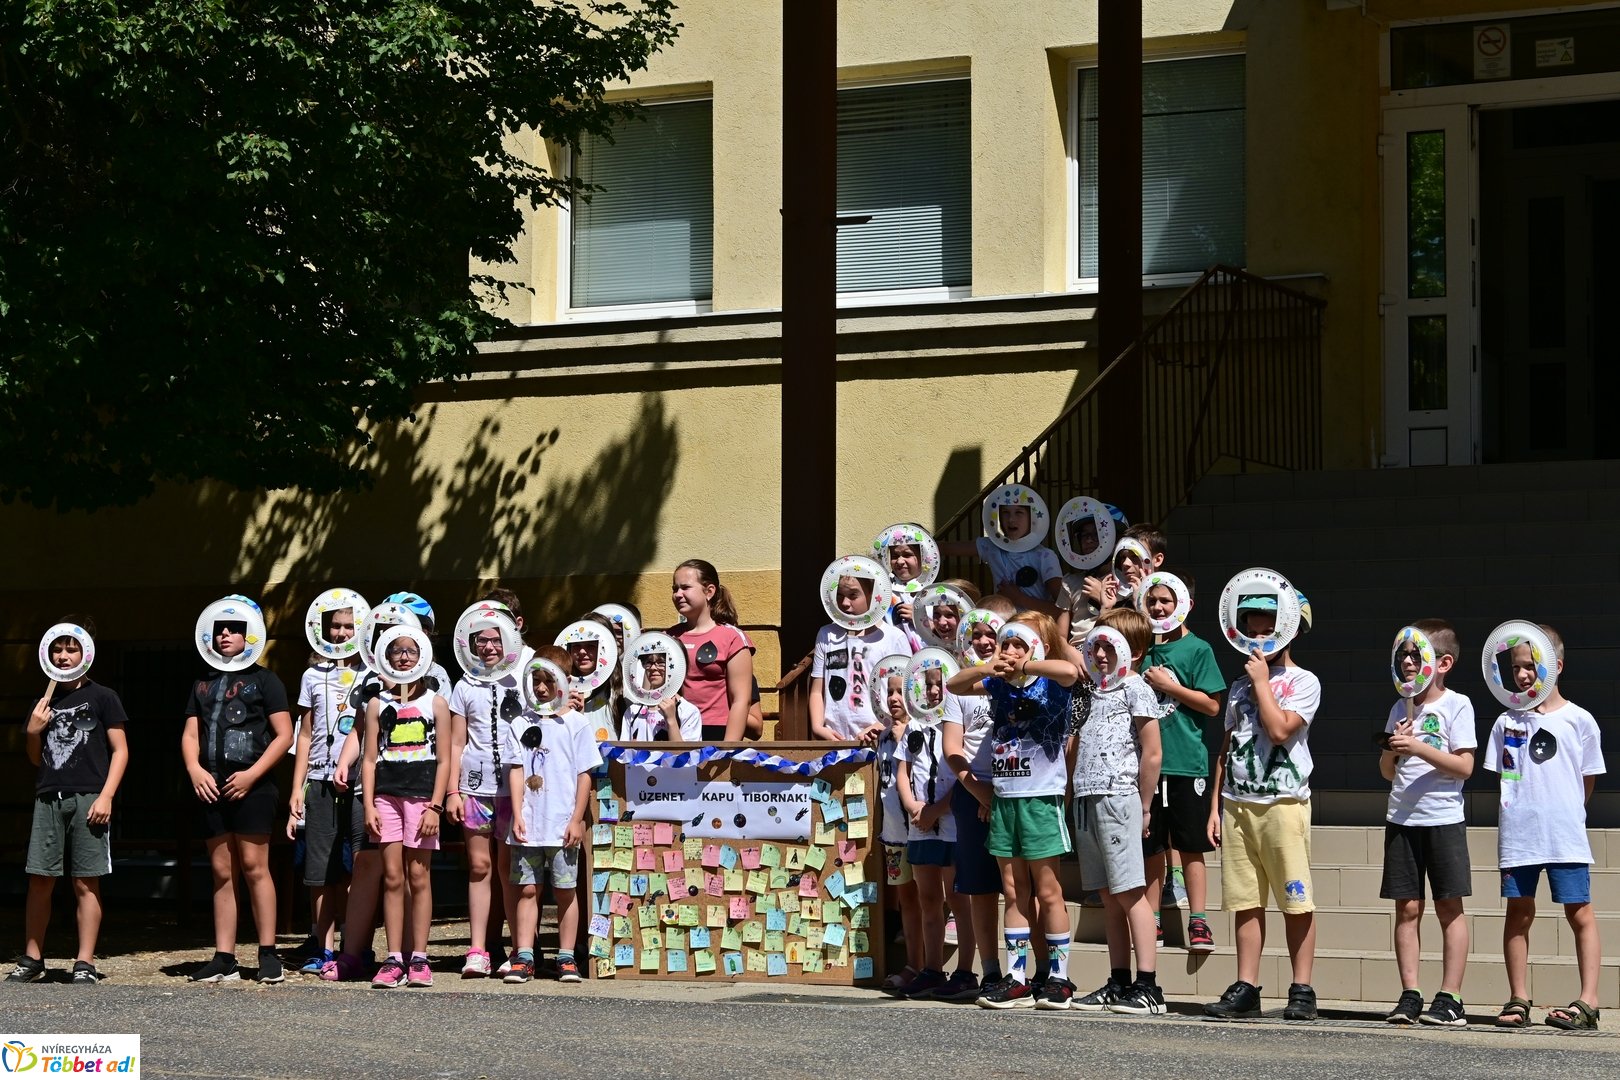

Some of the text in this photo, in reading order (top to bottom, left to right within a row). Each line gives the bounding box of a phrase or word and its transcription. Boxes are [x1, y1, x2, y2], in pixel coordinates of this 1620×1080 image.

[991, 757, 1031, 771] SONIC
[638, 790, 807, 803] ÜZENET KAPU TIBORNAK!
